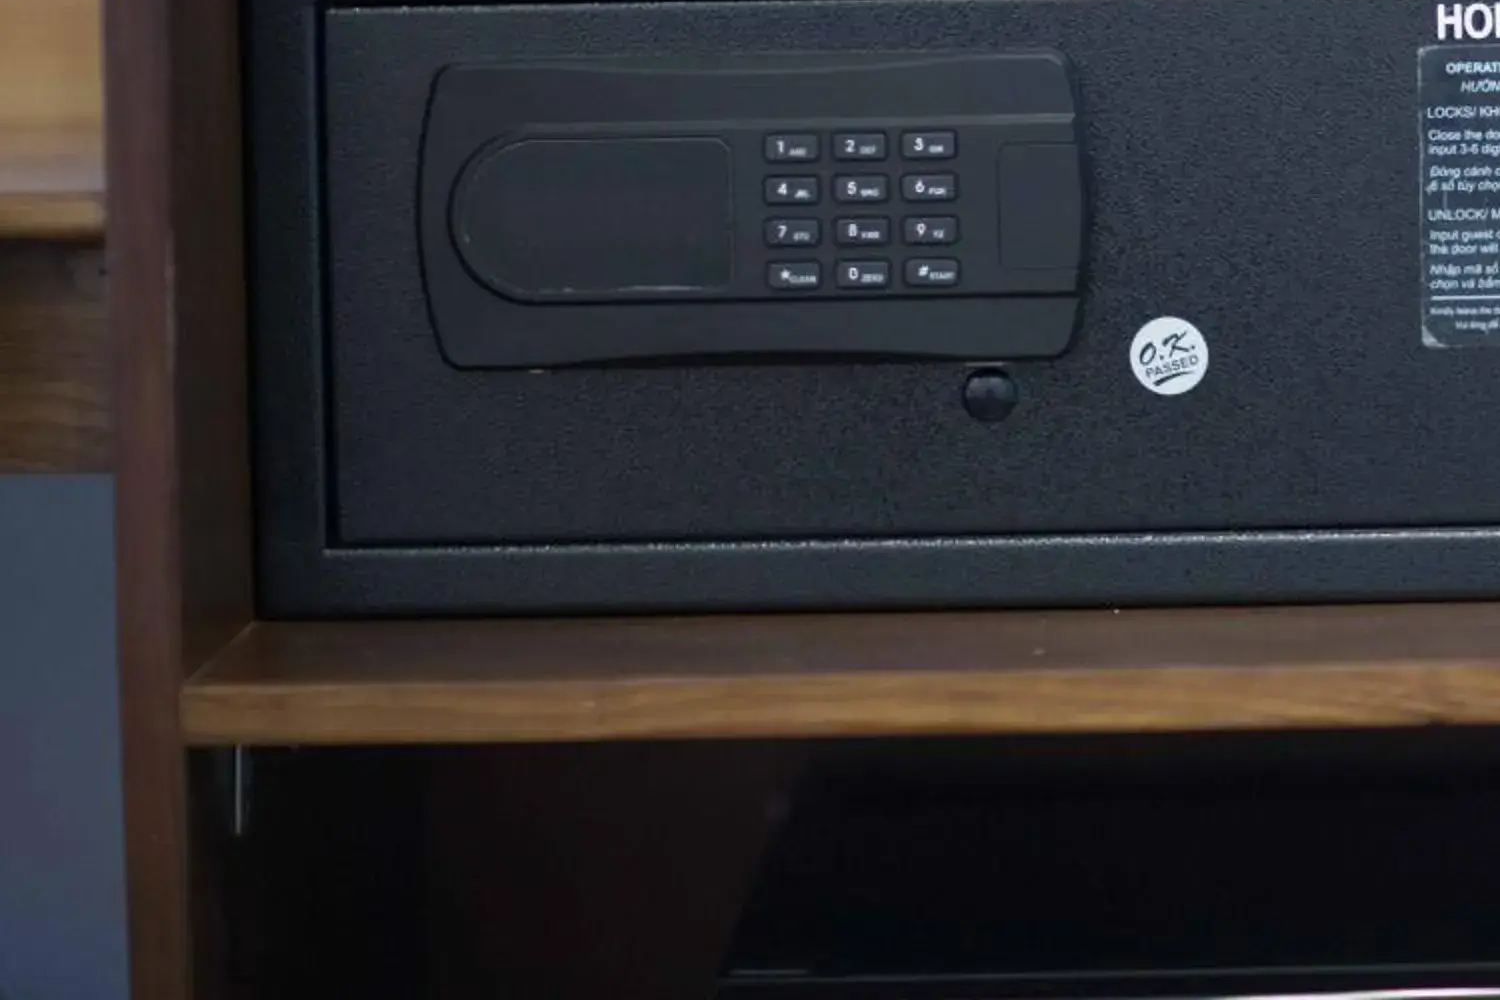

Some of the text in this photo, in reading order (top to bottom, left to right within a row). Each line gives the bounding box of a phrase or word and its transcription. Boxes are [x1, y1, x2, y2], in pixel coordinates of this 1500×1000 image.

[1428, 129, 1462, 141] Close
[1464, 129, 1483, 141] the
[776, 139, 785, 153] 1
[845, 139, 855, 153] 2
[914, 137, 924, 151] 3
[1459, 143, 1479, 155] 3-6
[777, 182, 788, 195] 4
[847, 180, 857, 195] 5
[914, 180, 925, 194] 6
[777, 225, 788, 239] 7
[848, 223, 857, 238] 8
[916, 222, 926, 237] 9
[1451, 242, 1477, 255] door
[918, 264, 929, 277] #
[1139, 330, 1196, 366] O.K.
[1145, 355, 1199, 379] PASSED
